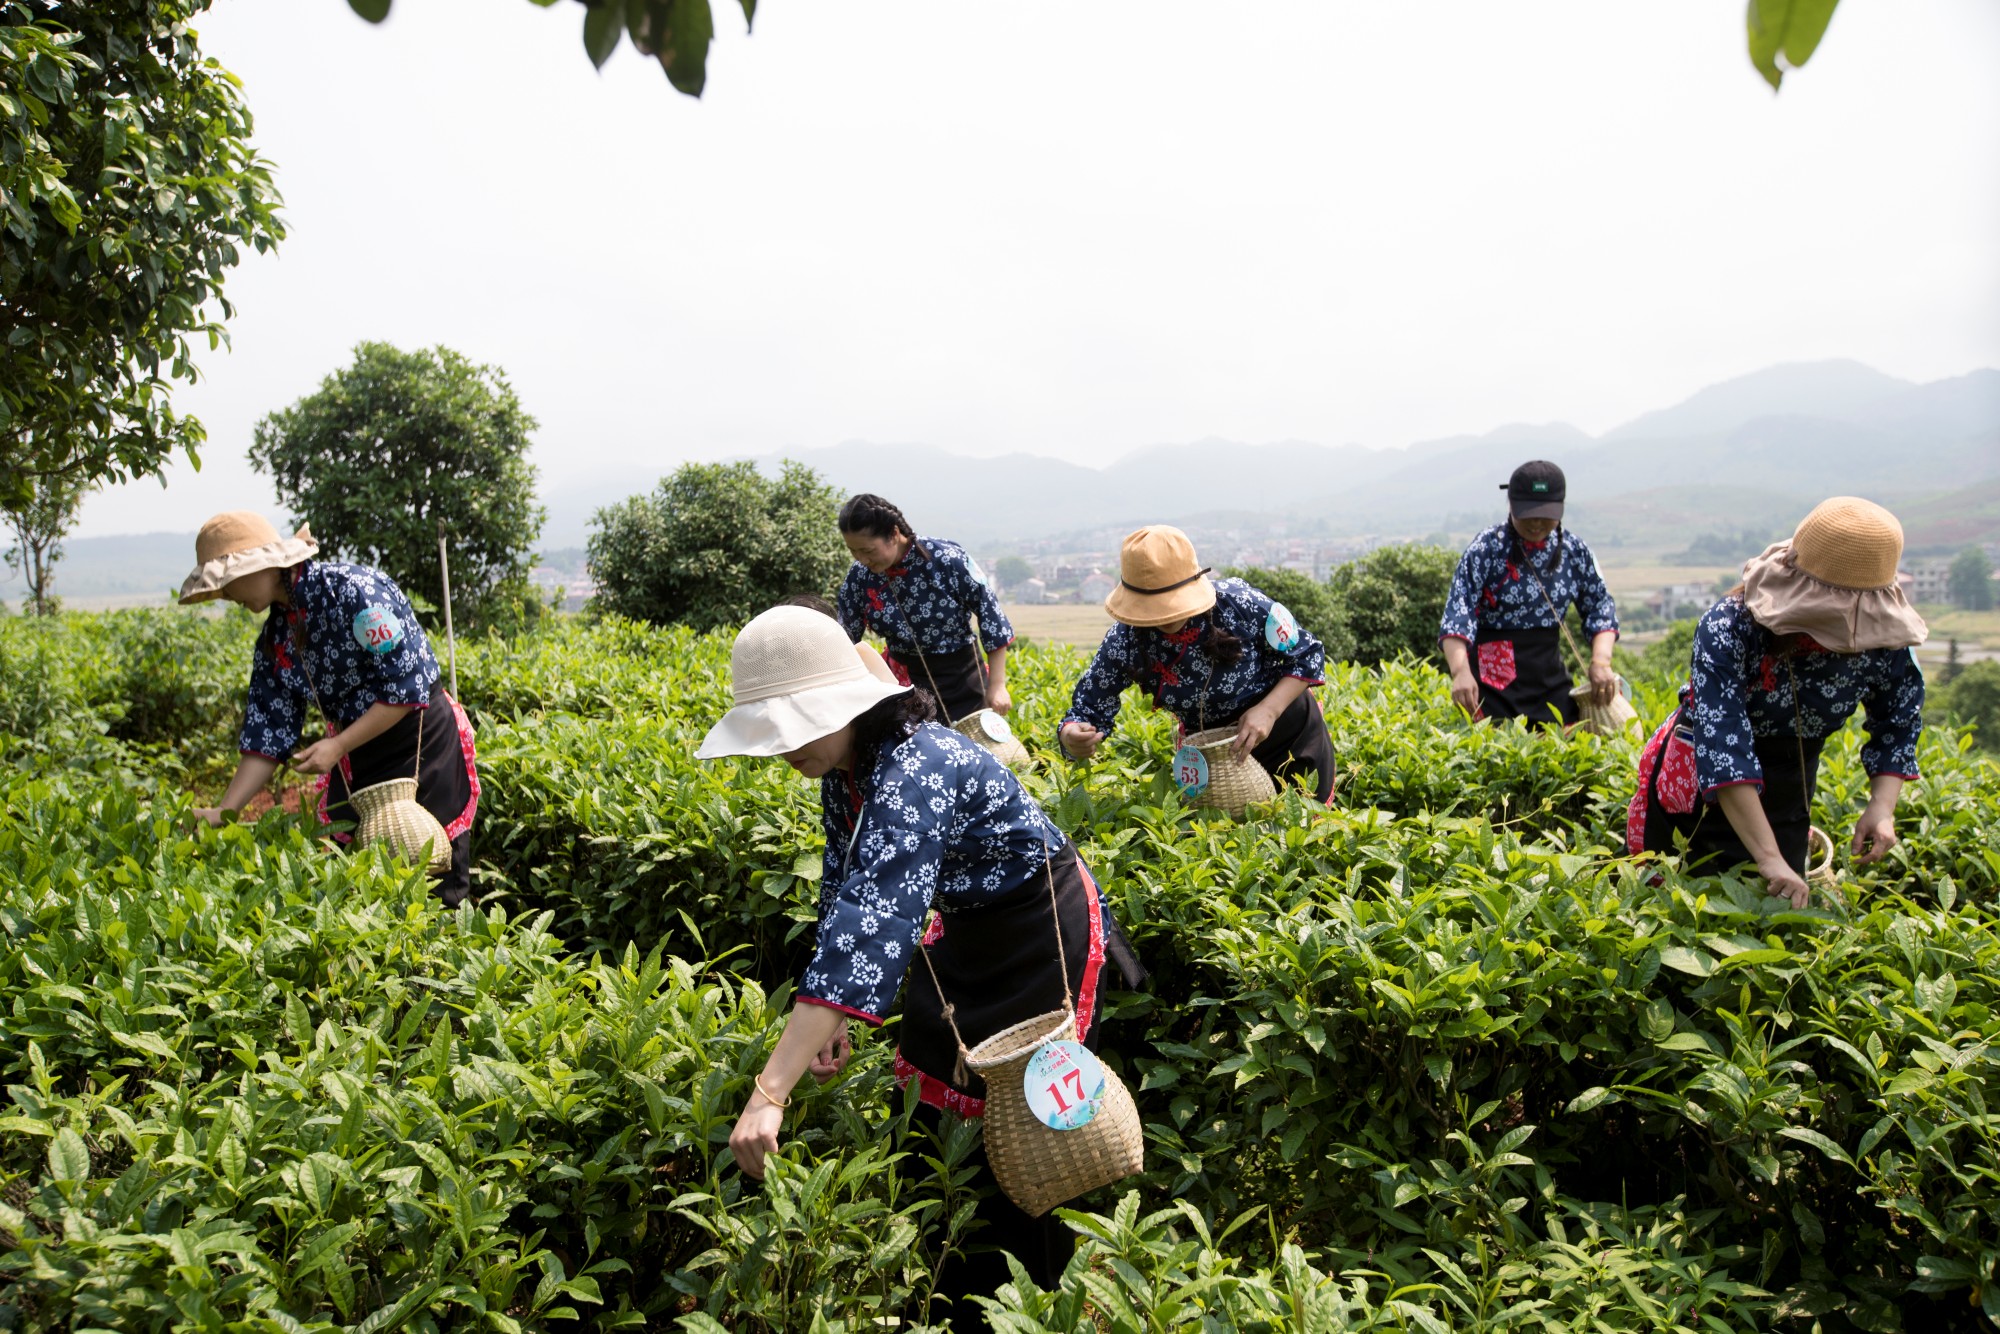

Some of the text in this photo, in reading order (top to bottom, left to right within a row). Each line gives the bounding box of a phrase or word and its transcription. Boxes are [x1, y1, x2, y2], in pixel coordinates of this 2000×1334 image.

[366, 624, 392, 646] 26
[1182, 766, 1199, 785] 53
[1046, 1068, 1086, 1115] 17
